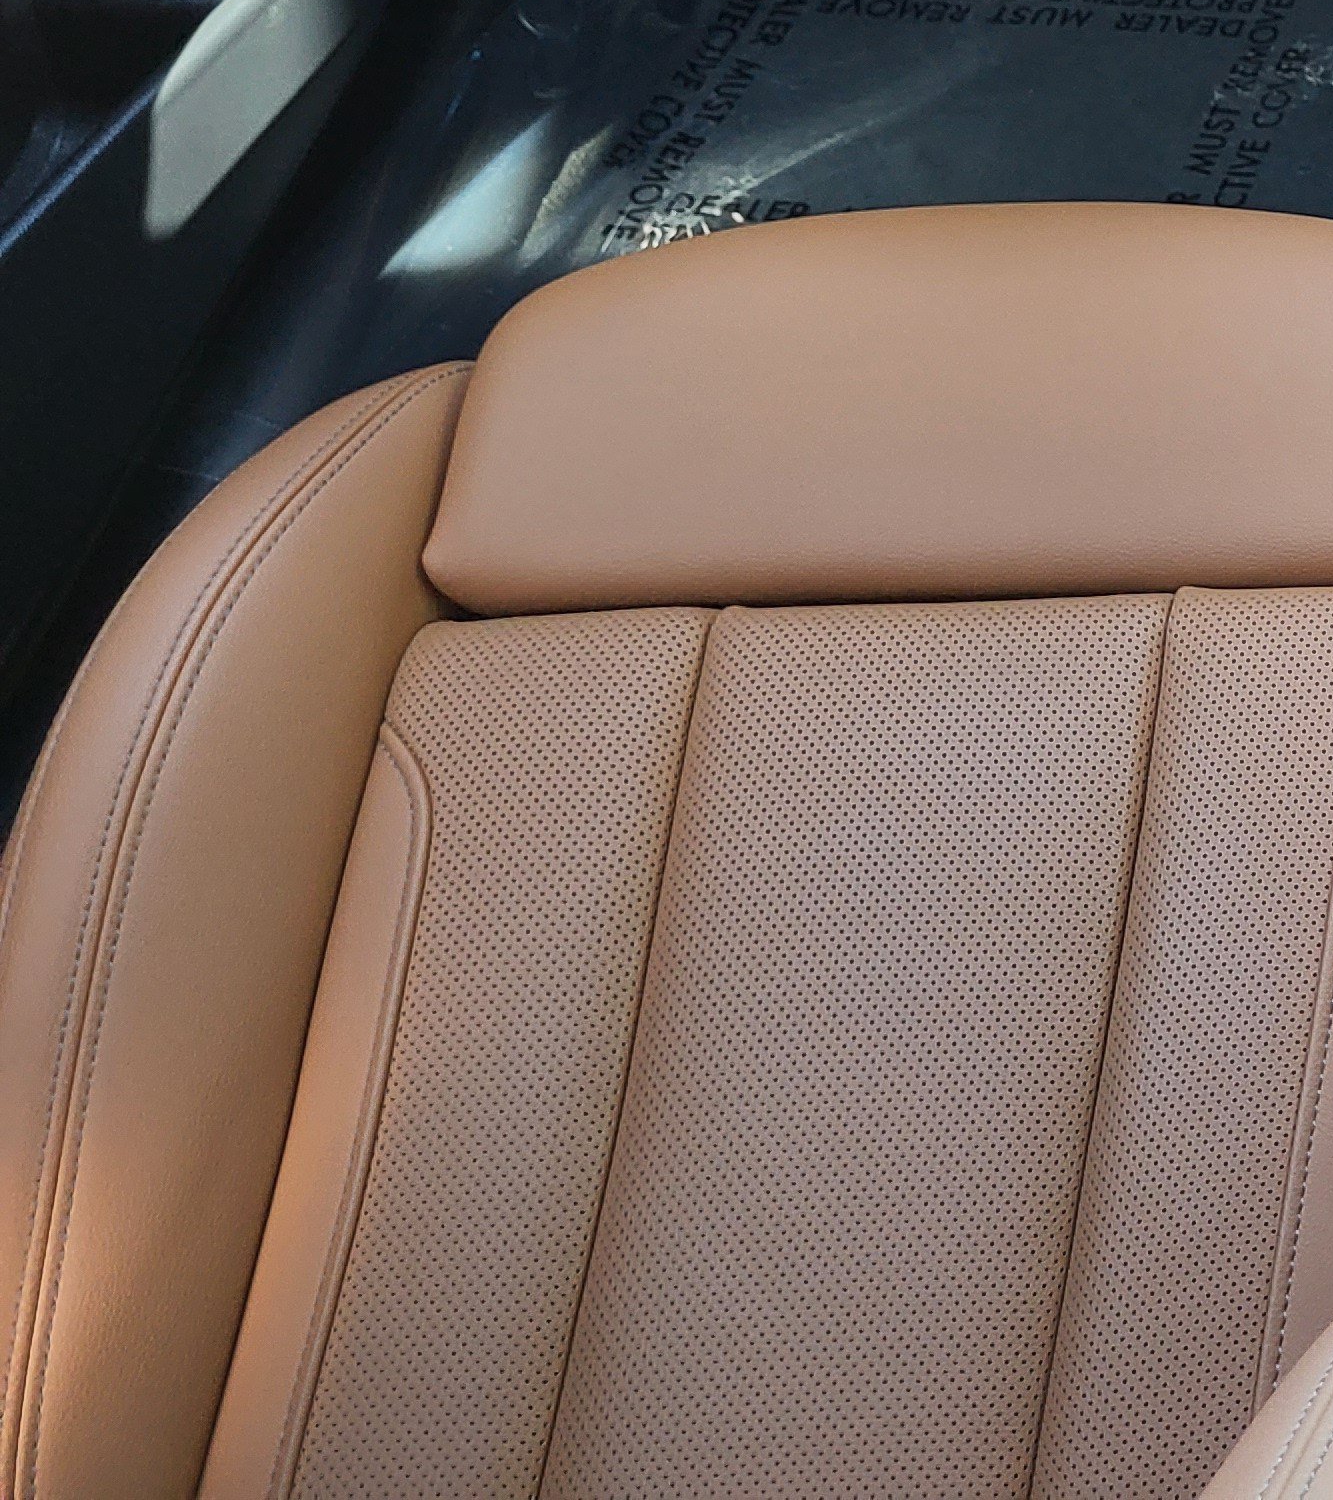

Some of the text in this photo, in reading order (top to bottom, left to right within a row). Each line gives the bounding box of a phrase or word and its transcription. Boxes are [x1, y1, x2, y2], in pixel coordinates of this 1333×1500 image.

[985, 2, 1096, 30] MUST
[1114, 12, 1247, 38] DEALER
[1188, 100, 1239, 176] MUST
